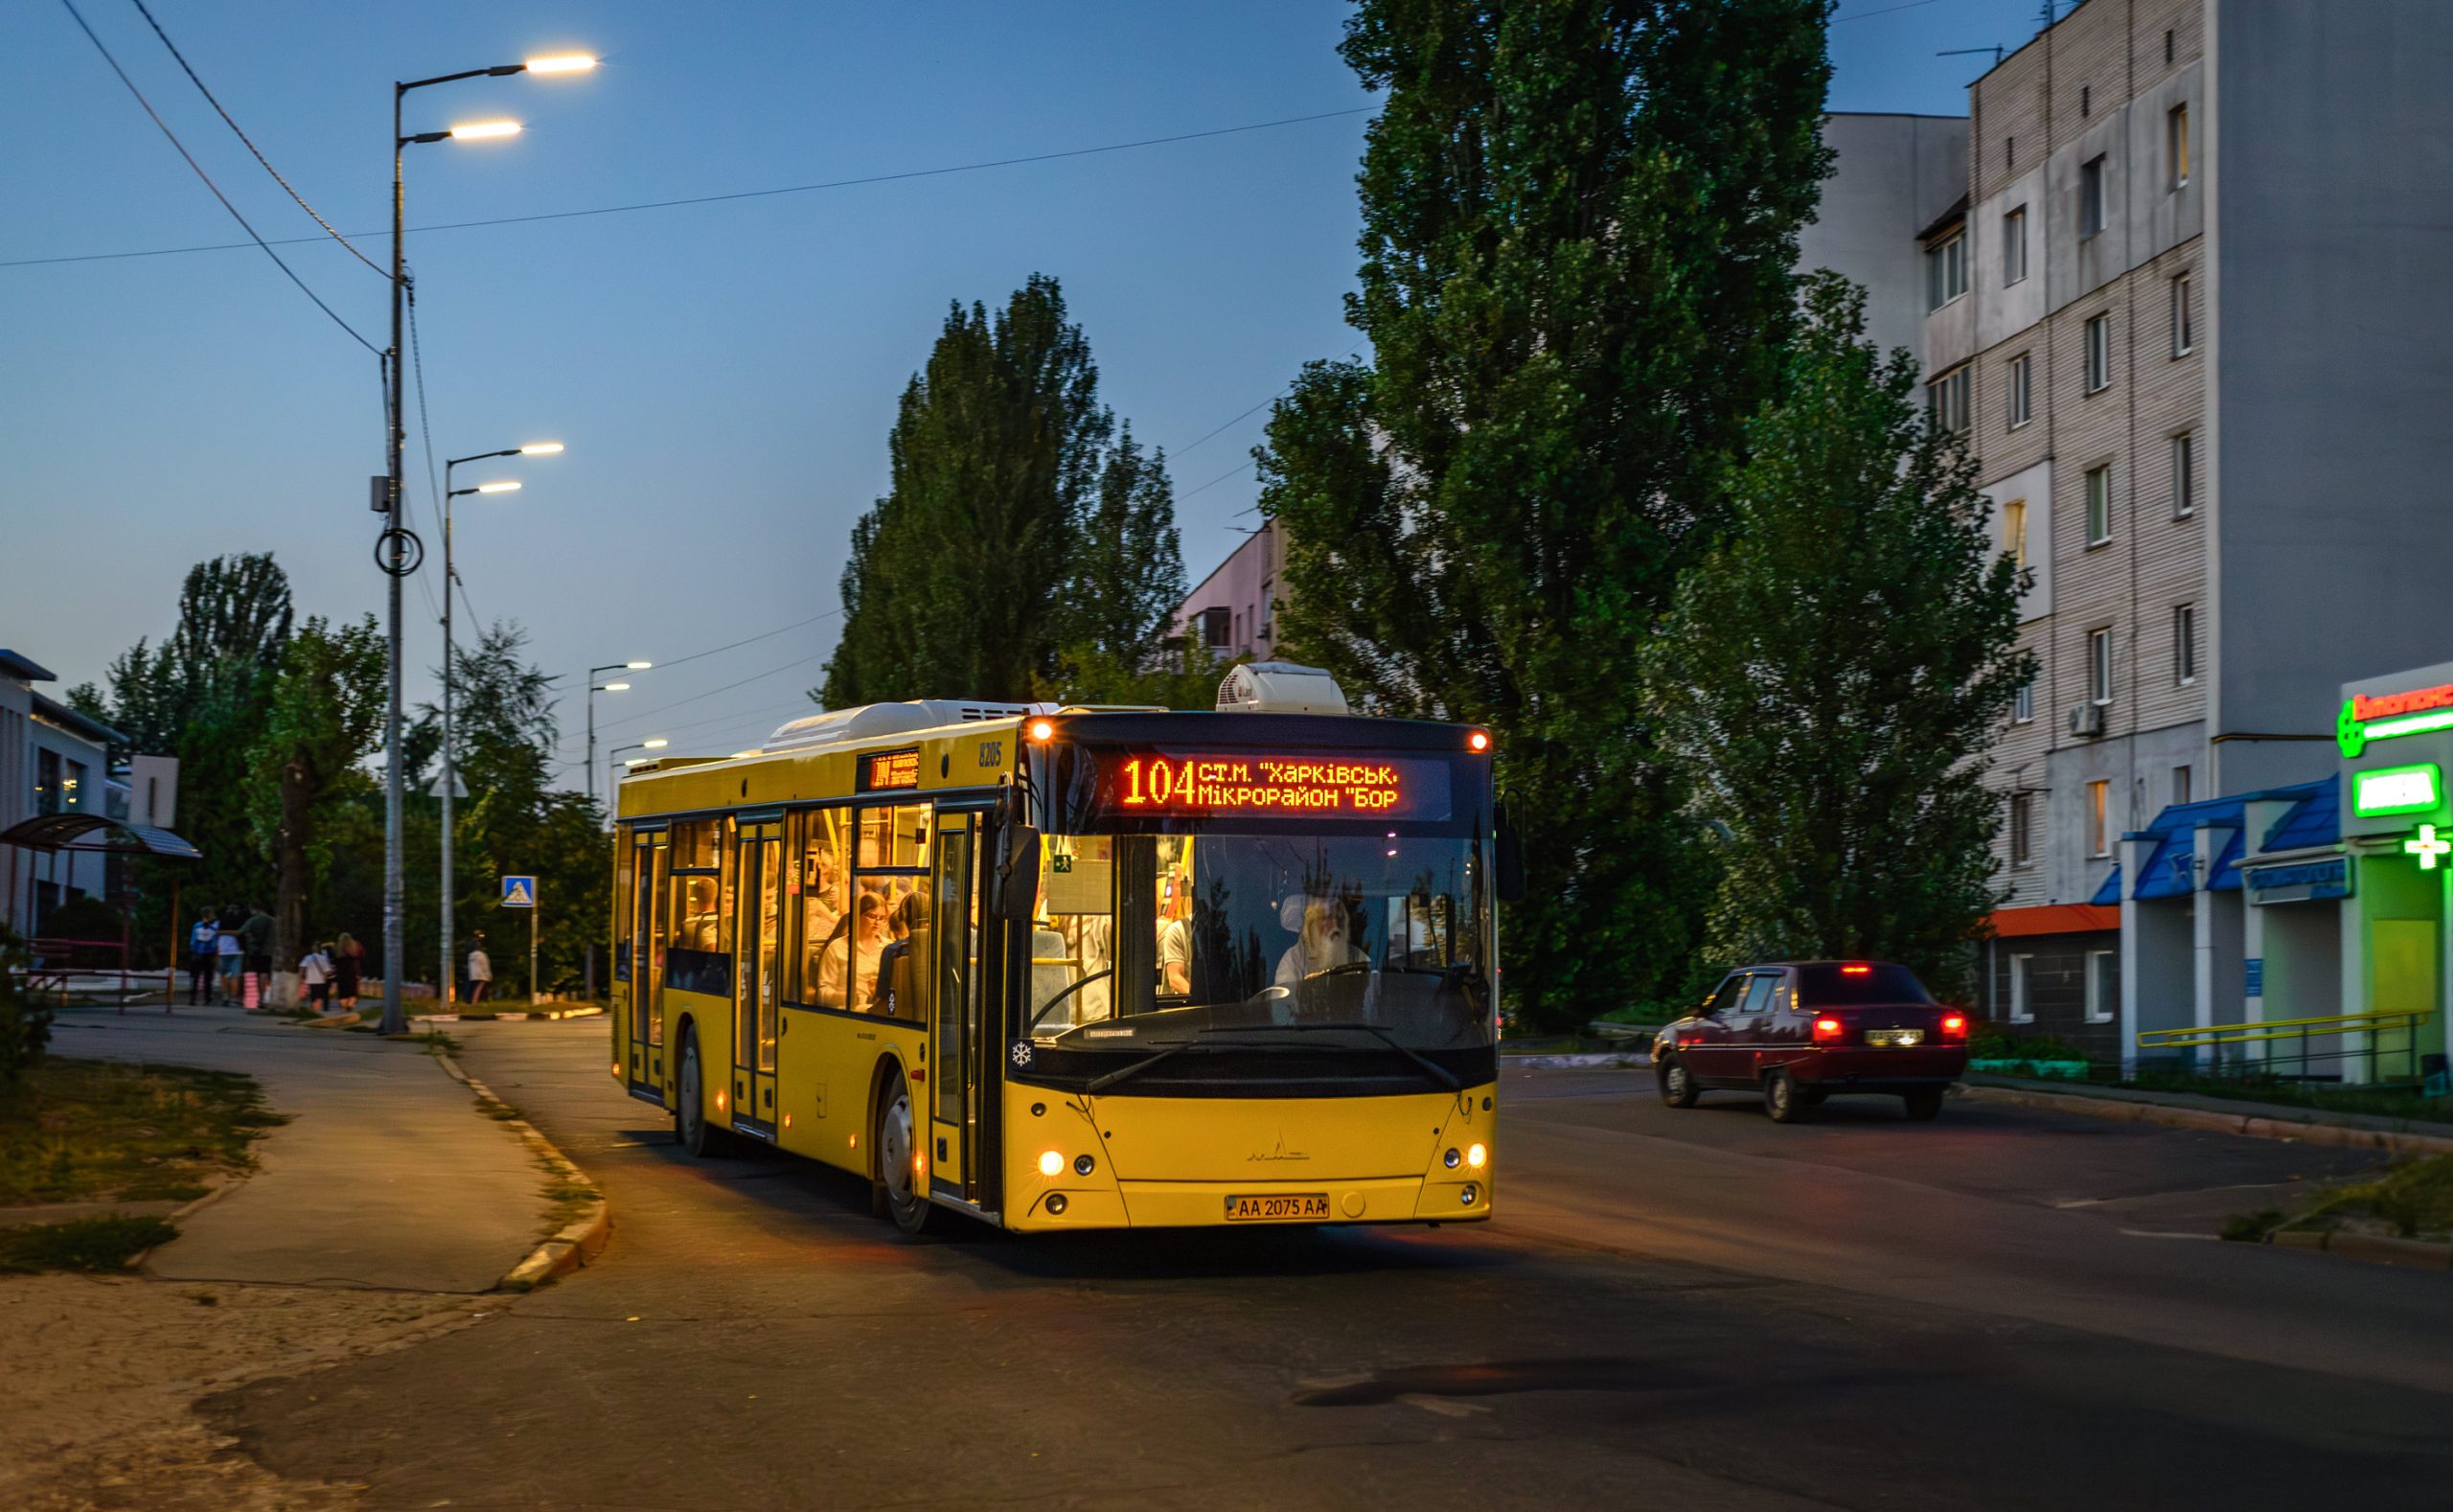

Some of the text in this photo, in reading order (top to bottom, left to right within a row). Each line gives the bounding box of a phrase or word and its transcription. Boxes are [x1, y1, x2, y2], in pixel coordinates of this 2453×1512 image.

[978, 742, 1002, 767] 8205
[1124, 760, 1196, 804] 104
[1198, 784, 1398, 808] Мікрорайон "Бор
[1265, 1199, 1300, 1216] 2075
